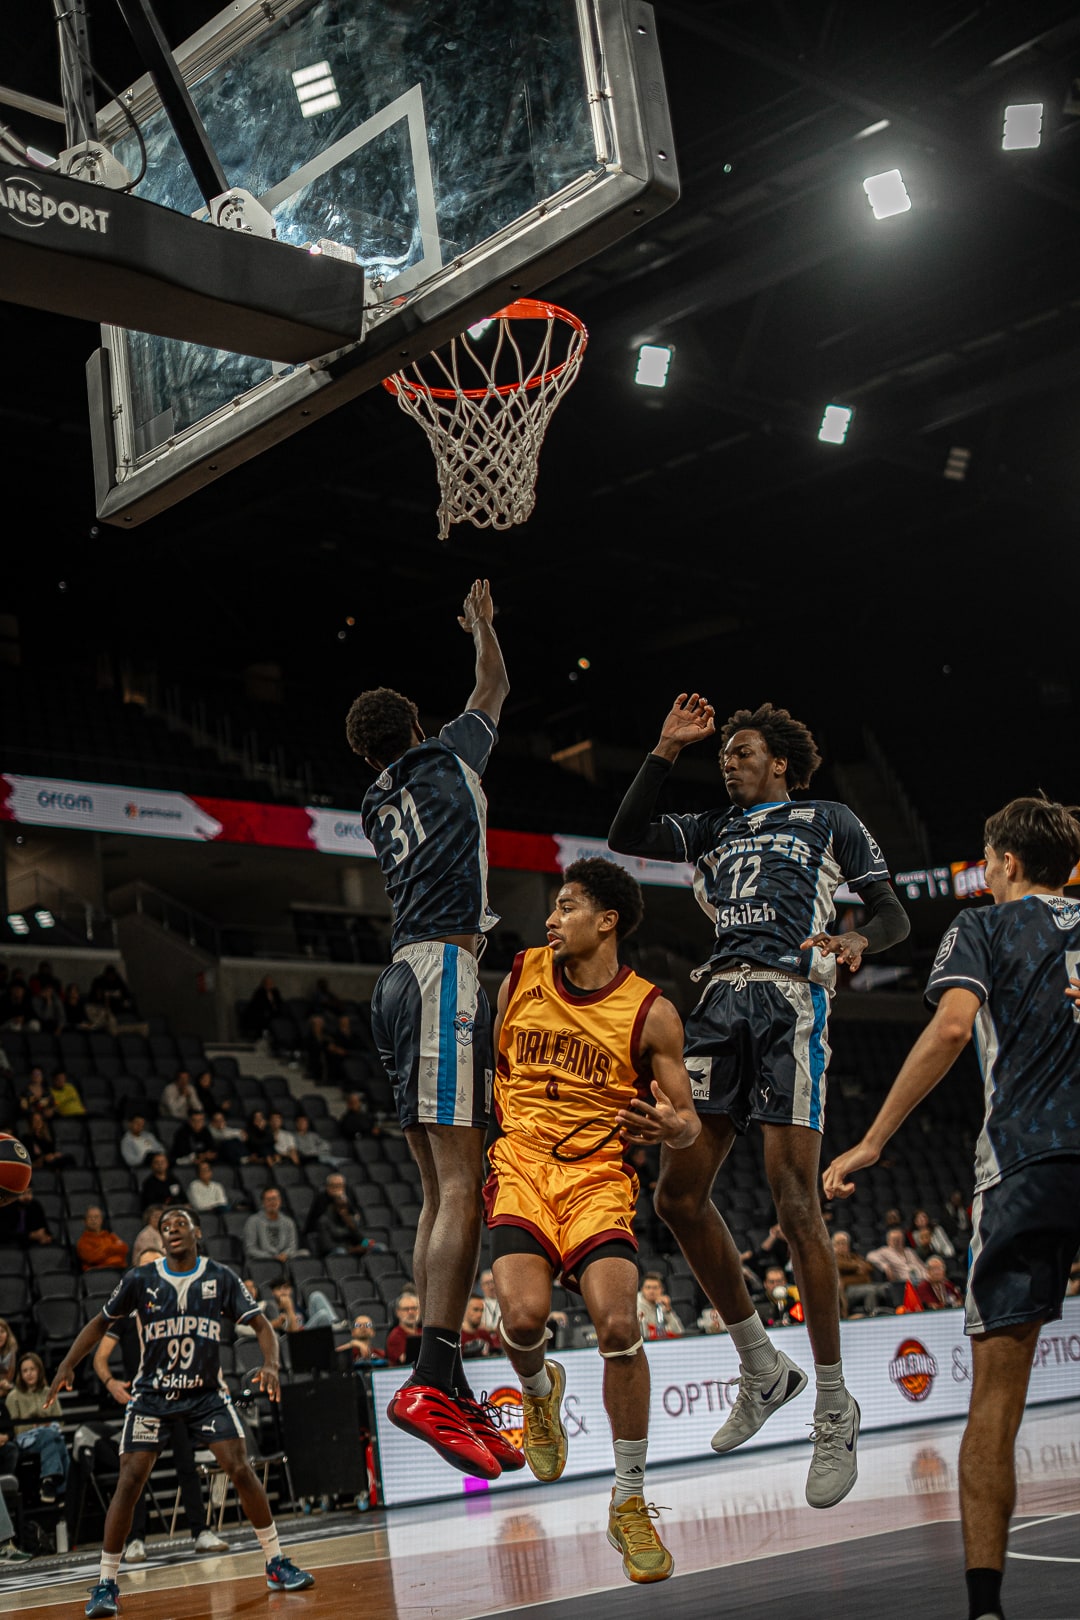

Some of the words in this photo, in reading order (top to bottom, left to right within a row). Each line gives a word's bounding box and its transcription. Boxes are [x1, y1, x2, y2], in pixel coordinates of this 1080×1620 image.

[377, 787, 427, 865] 31
[728, 854, 762, 900] 12
[515, 1027, 613, 1090] ORLÉANS
[143, 1315, 221, 1343] KEMPER
[166, 1337, 195, 1371] 99
[563, 1394, 590, 1437] &
